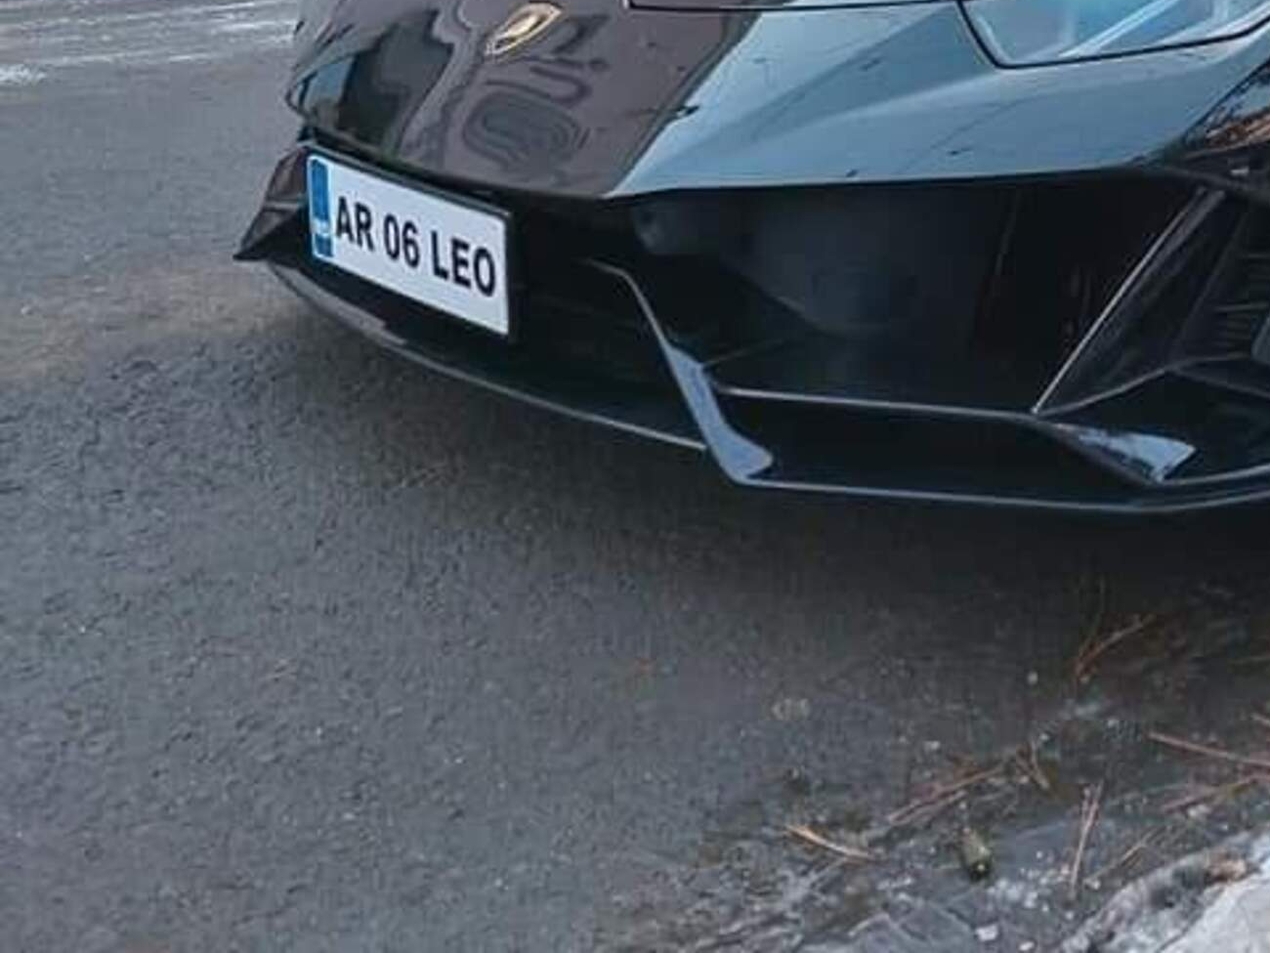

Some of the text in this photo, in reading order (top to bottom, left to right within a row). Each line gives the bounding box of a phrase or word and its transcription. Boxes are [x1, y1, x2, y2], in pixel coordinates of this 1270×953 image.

[337, 197, 495, 297] AR 06 LEO
